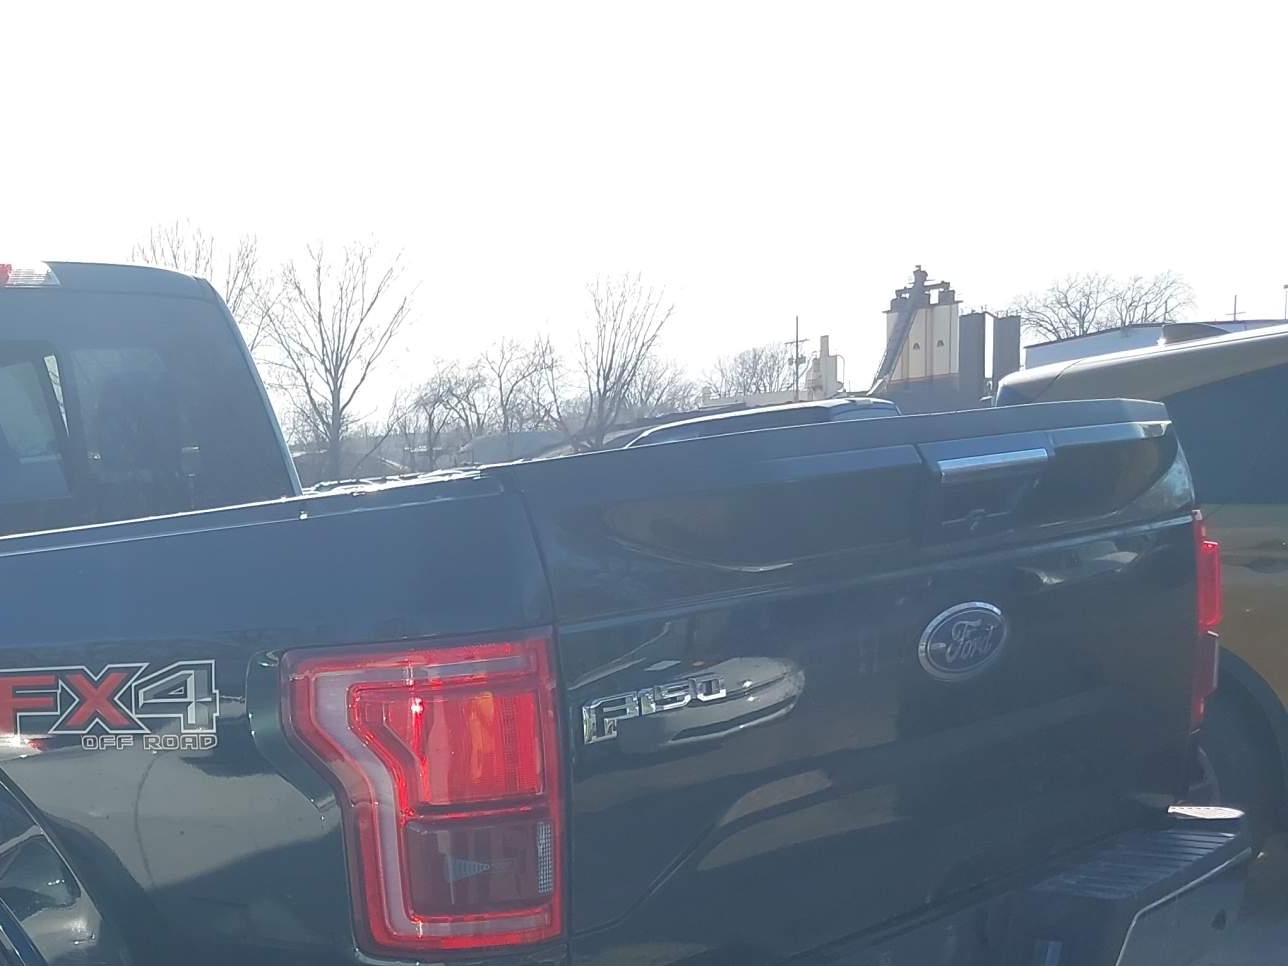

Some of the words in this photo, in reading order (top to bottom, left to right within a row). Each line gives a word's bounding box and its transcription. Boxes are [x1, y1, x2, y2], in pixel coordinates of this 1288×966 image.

[945, 618, 995, 663] Ford
[81, 734, 134, 750] OFF
[143, 734, 218, 750] ROAD
